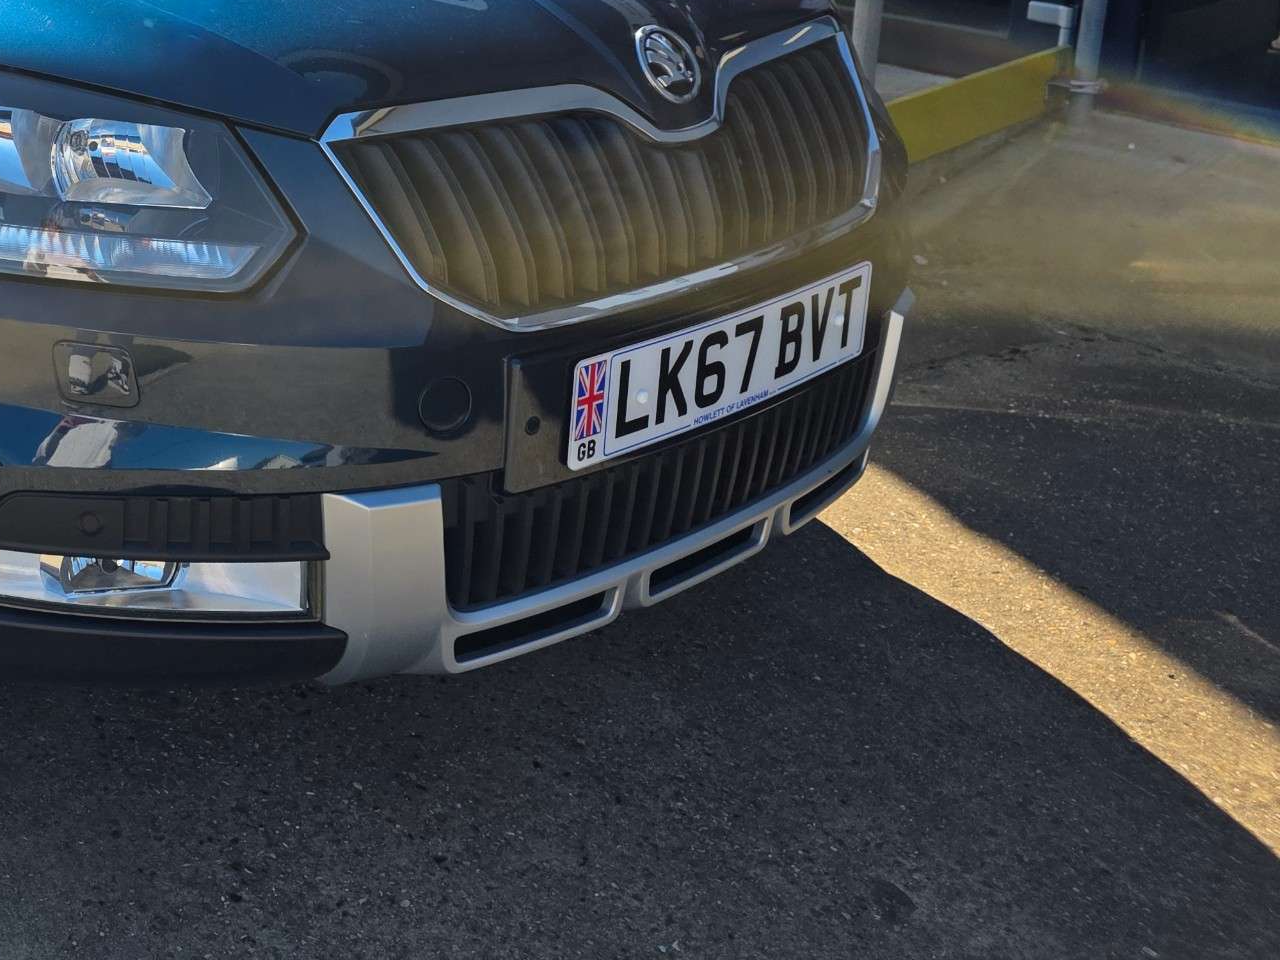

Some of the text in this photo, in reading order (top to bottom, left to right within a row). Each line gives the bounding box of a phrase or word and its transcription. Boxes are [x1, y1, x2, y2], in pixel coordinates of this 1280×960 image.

[614, 275, 863, 440] LK67 BVT
[692, 388, 770, 426] HOWLETT OF LAVENHAM
[576, 439, 597, 462] GB
